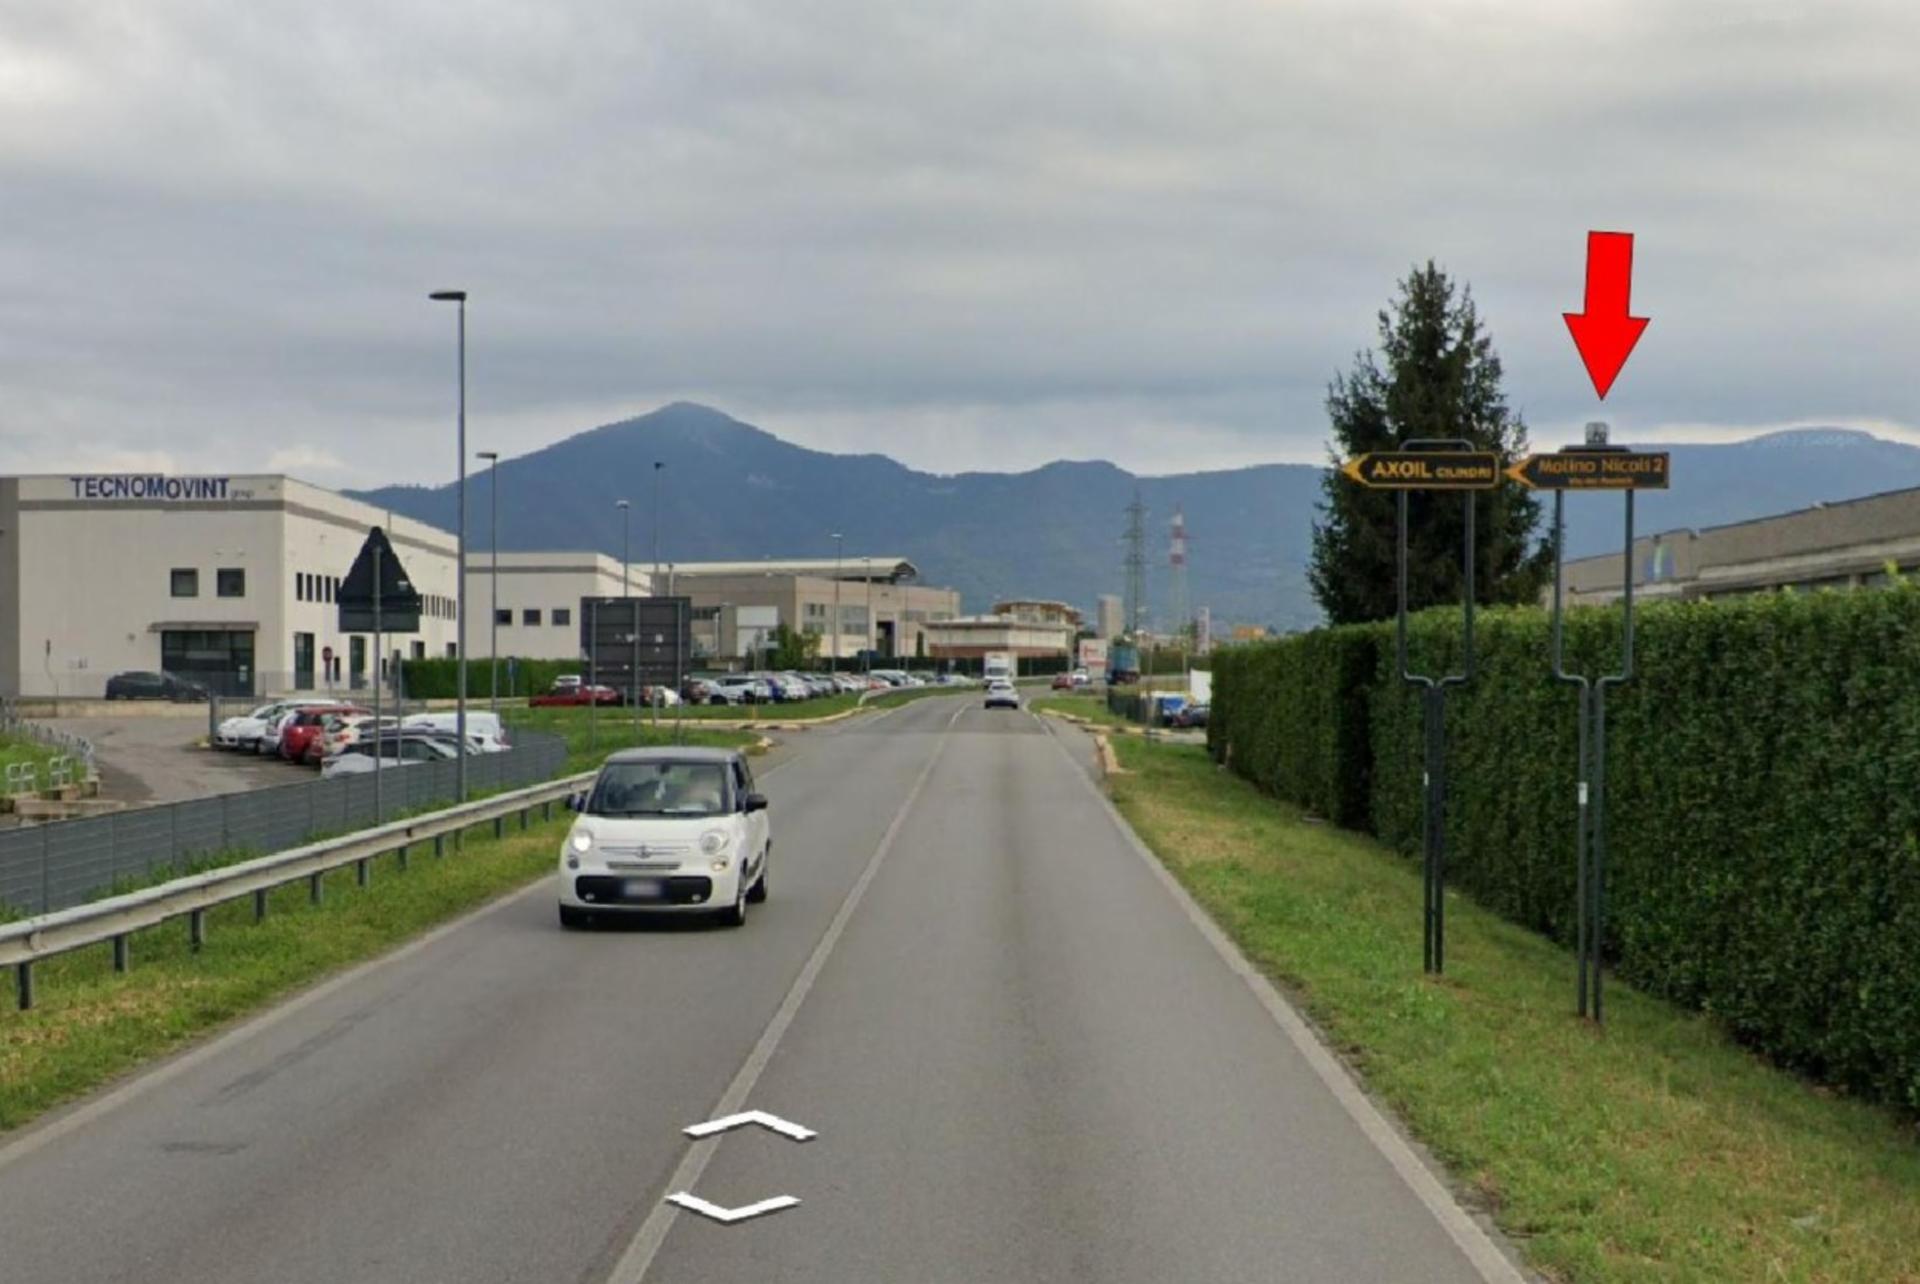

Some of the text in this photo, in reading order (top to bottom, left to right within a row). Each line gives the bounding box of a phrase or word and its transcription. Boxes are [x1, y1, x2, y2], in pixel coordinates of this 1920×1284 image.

[1373, 461, 1432, 478] AXOIL
[1539, 458, 1663, 474] Molino Nicoli 2
[70, 476, 229, 499] TECNOMOVINT
